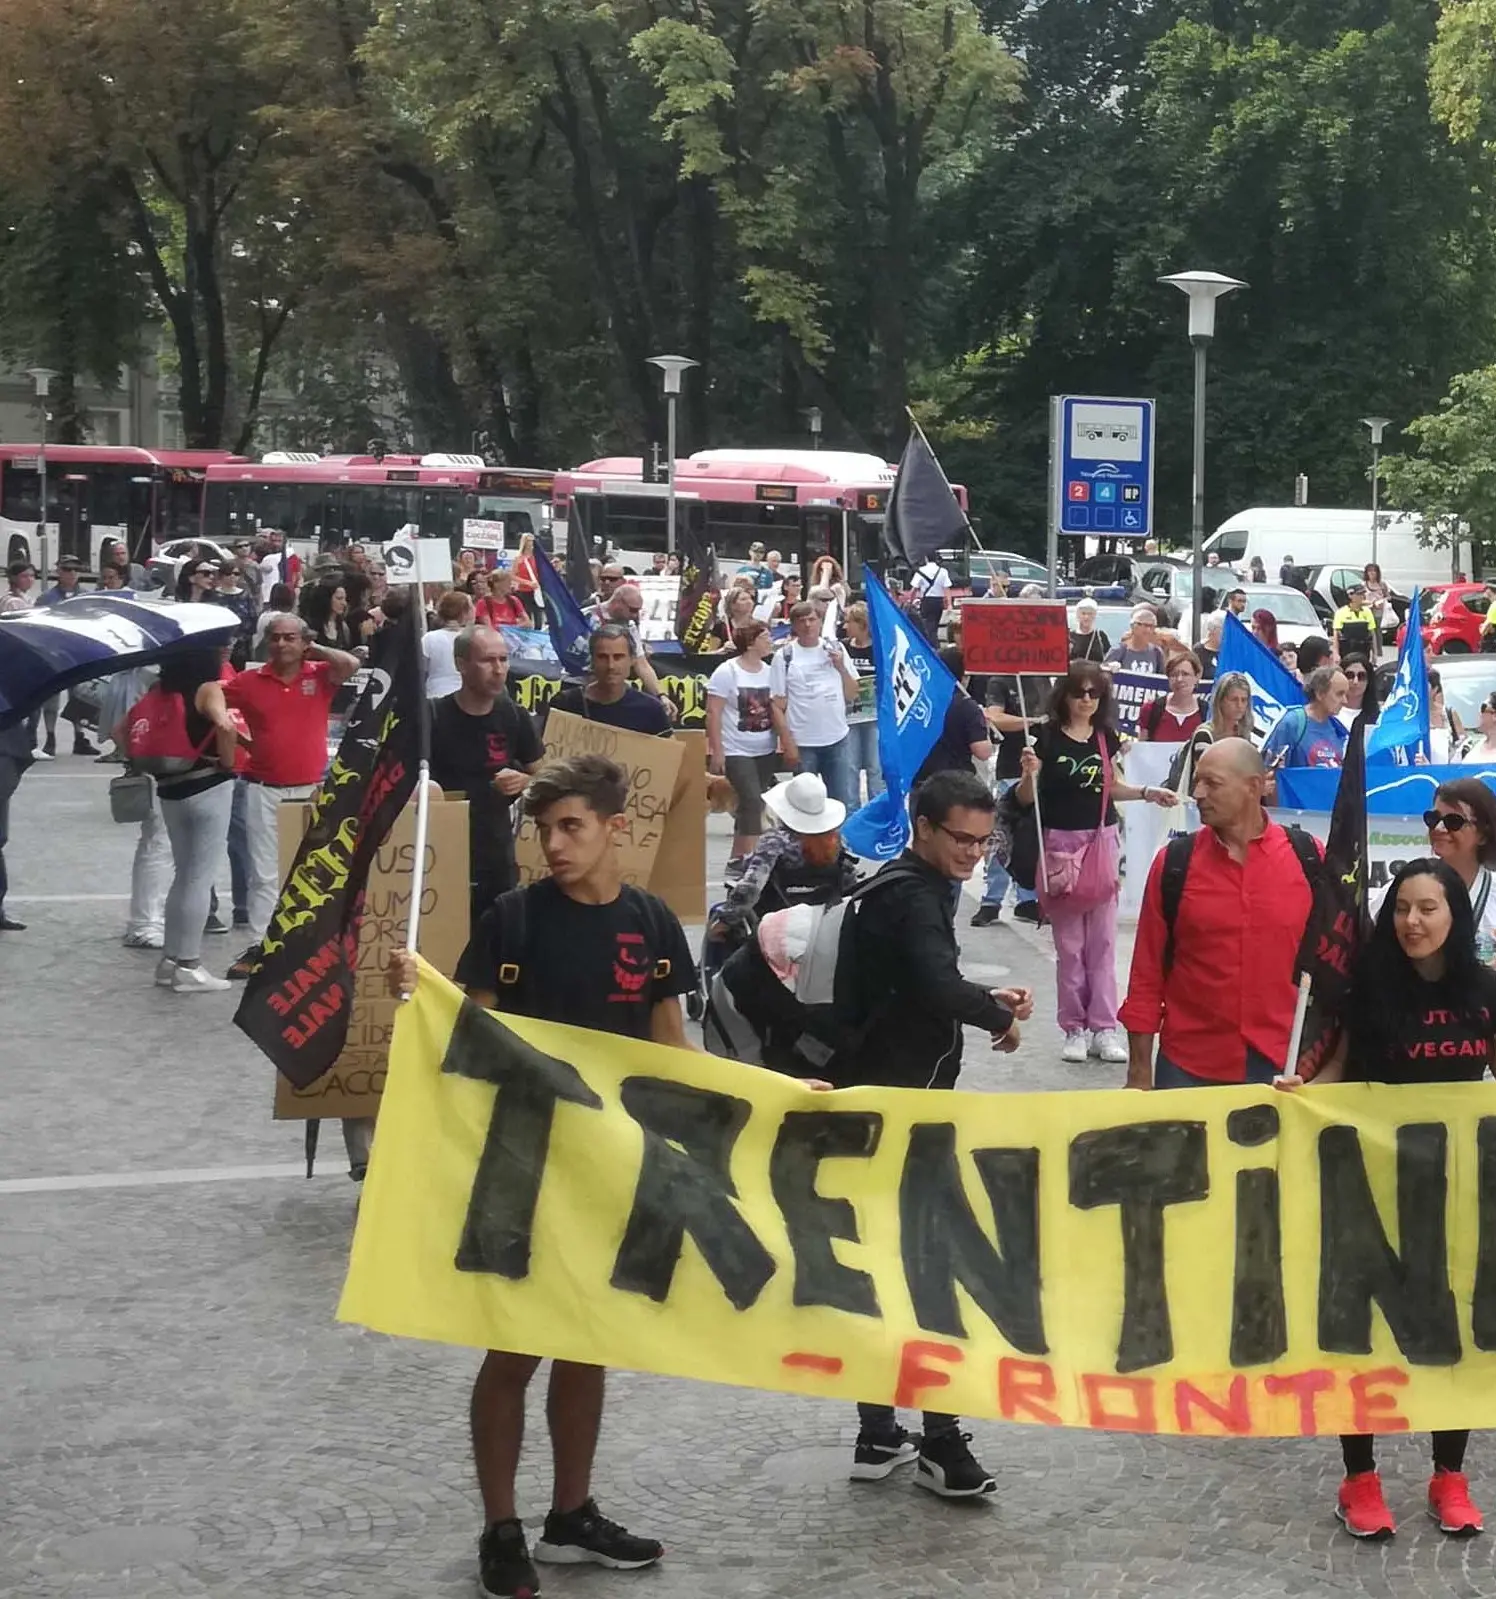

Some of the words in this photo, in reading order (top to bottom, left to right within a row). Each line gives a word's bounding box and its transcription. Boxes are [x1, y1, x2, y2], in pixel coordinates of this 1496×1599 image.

[1074, 486, 1084, 497] 2
[1100, 487, 1110, 498] 4
[1406, 1039, 1488, 1060] VEGAN
